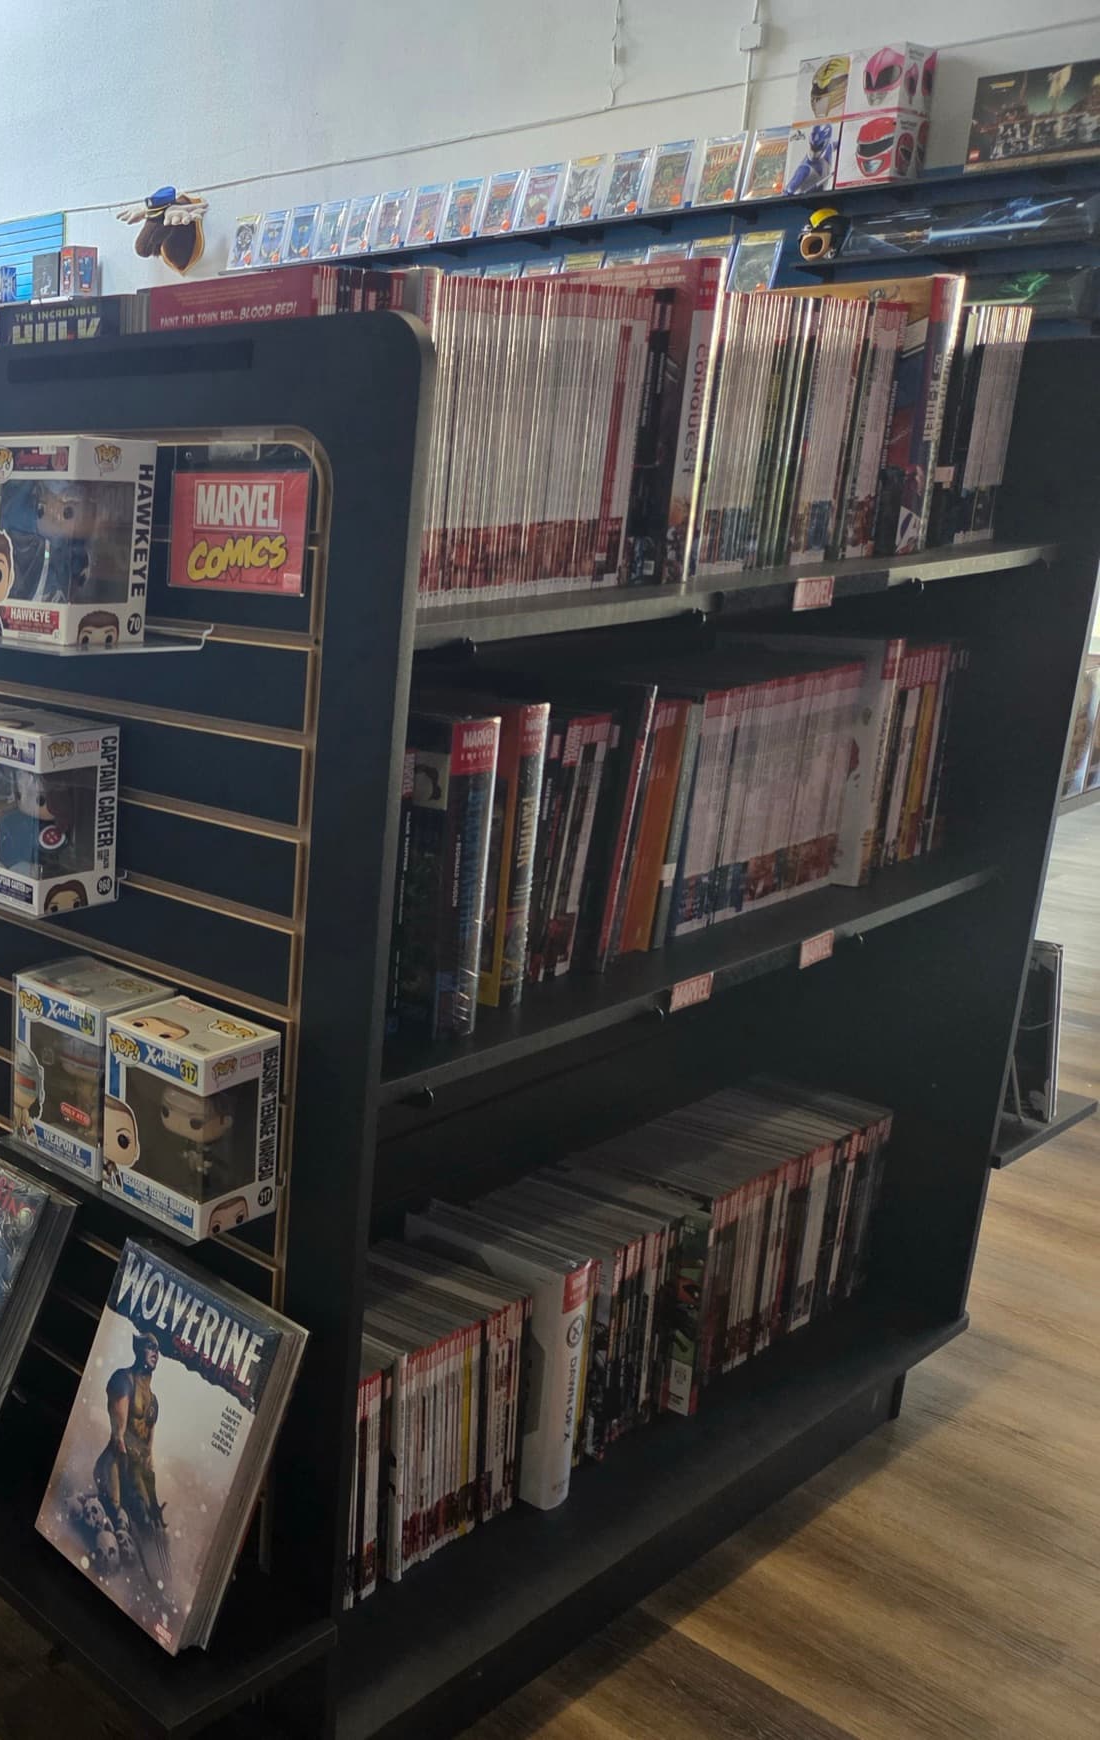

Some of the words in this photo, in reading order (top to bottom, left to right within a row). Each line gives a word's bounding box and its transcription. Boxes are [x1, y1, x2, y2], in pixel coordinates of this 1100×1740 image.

[15, 313, 35, 323] THE
[37, 305, 98, 320] INCREDIBLE
[181, 315, 195, 326] THE
[240, 303, 273, 320] BLOOD
[275, 300, 297, 316] RED!
[196, 483, 279, 528] MARVEL
[130, 464, 154, 598] HAWKEYE
[187, 535, 288, 582] COMICS
[10, 607, 51, 624] HAWKEYE
[128, 616, 141, 631] 70
[463, 727, 495, 748] MARVEL
[99, 736, 118, 793] CAPTAIN
[97, 796, 115, 848] CARTER
[19, 990, 43, 1016] POP!
[109, 1031, 139, 1062] POP!
[181, 1062, 196, 1081] 317
[260, 1097, 277, 1139] TEENAGE
[43, 1130, 73, 1155] WEAPON
[75, 1147, 81, 1159] X
[258, 1136, 275, 1182] WARHEAD
[116, 1250, 265, 1387] WOLVERINE
